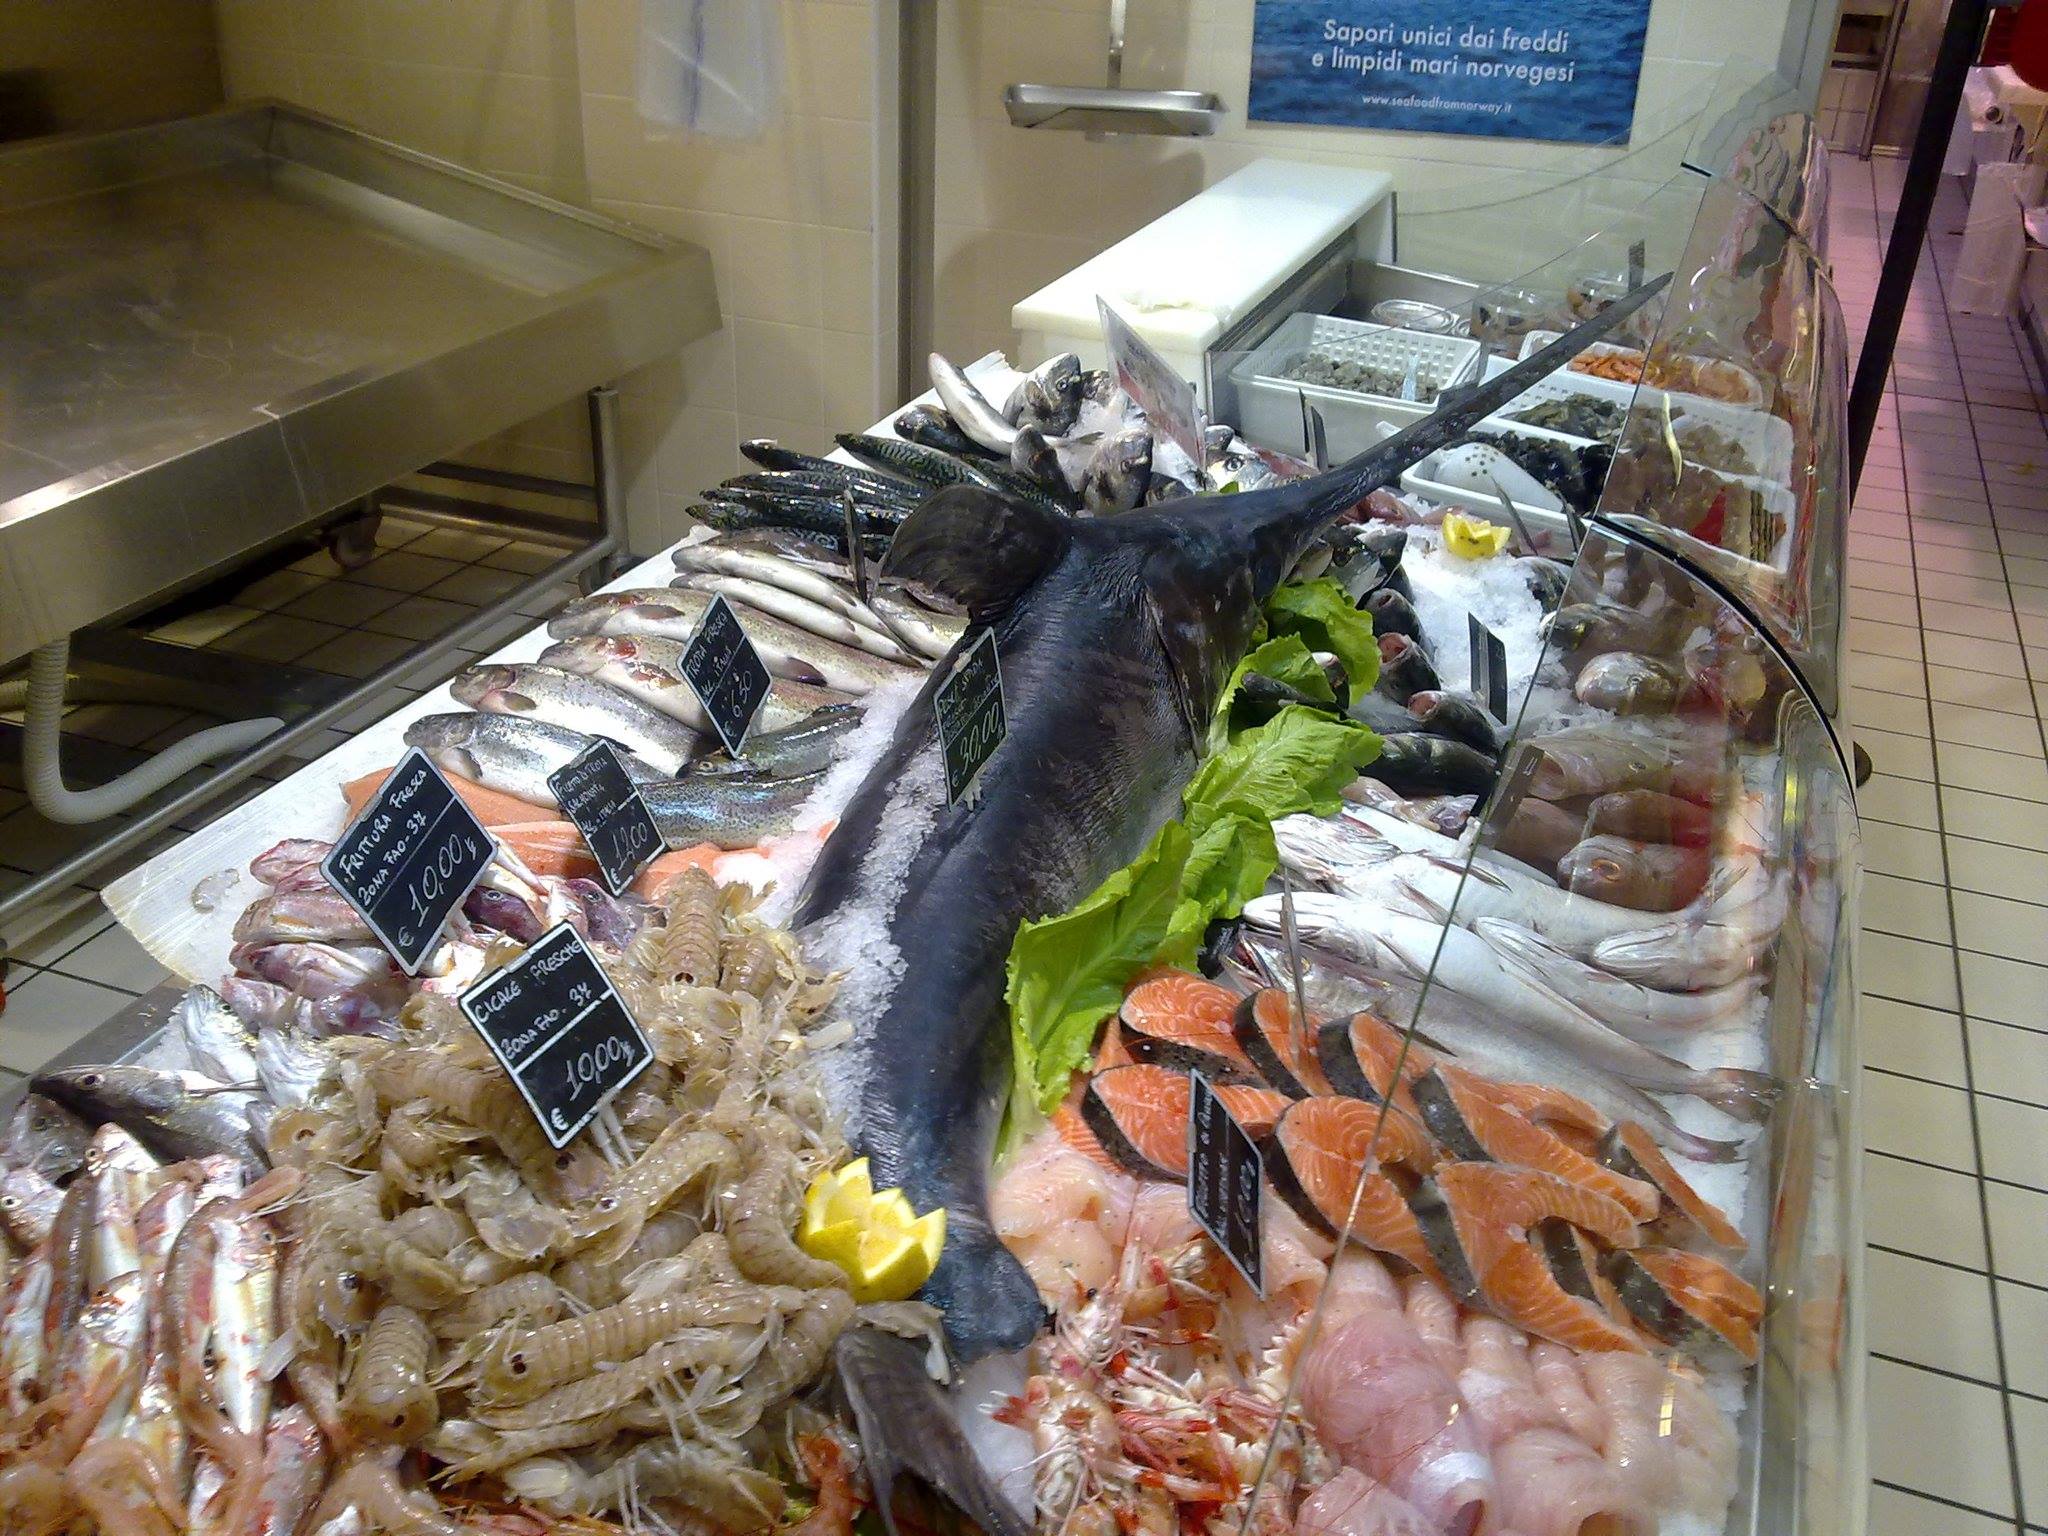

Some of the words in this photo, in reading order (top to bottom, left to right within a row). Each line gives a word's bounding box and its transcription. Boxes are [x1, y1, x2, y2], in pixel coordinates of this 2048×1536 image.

[1323, 19, 1394, 46] Sapori
[1402, 26, 1451, 48] unici
[1460, 27, 1495, 50] dai
[1502, 28, 1570, 53] freddi
[1312, 52, 1324, 68] e
[1331, 47, 1401, 76] limpidi
[1410, 54, 1458, 75] mari
[1466, 61, 1576, 87] norvegesi
[1362, 94, 1513, 114] www.seafoodfromnorway.it
[341, 813, 391, 880] FRITTURA
[389, 769, 428, 810] FRESCA
[357, 869, 390, 907] ZONA
[398, 926, 415, 947] €
[409, 833, 462, 927] 10,00
[475, 980, 522, 1024] CICALE
[530, 939, 584, 980] FRESCHE
[500, 1028, 538, 1060] ZONA
[550, 1107, 569, 1132] €
[566, 1036, 622, 1101] 10,00
